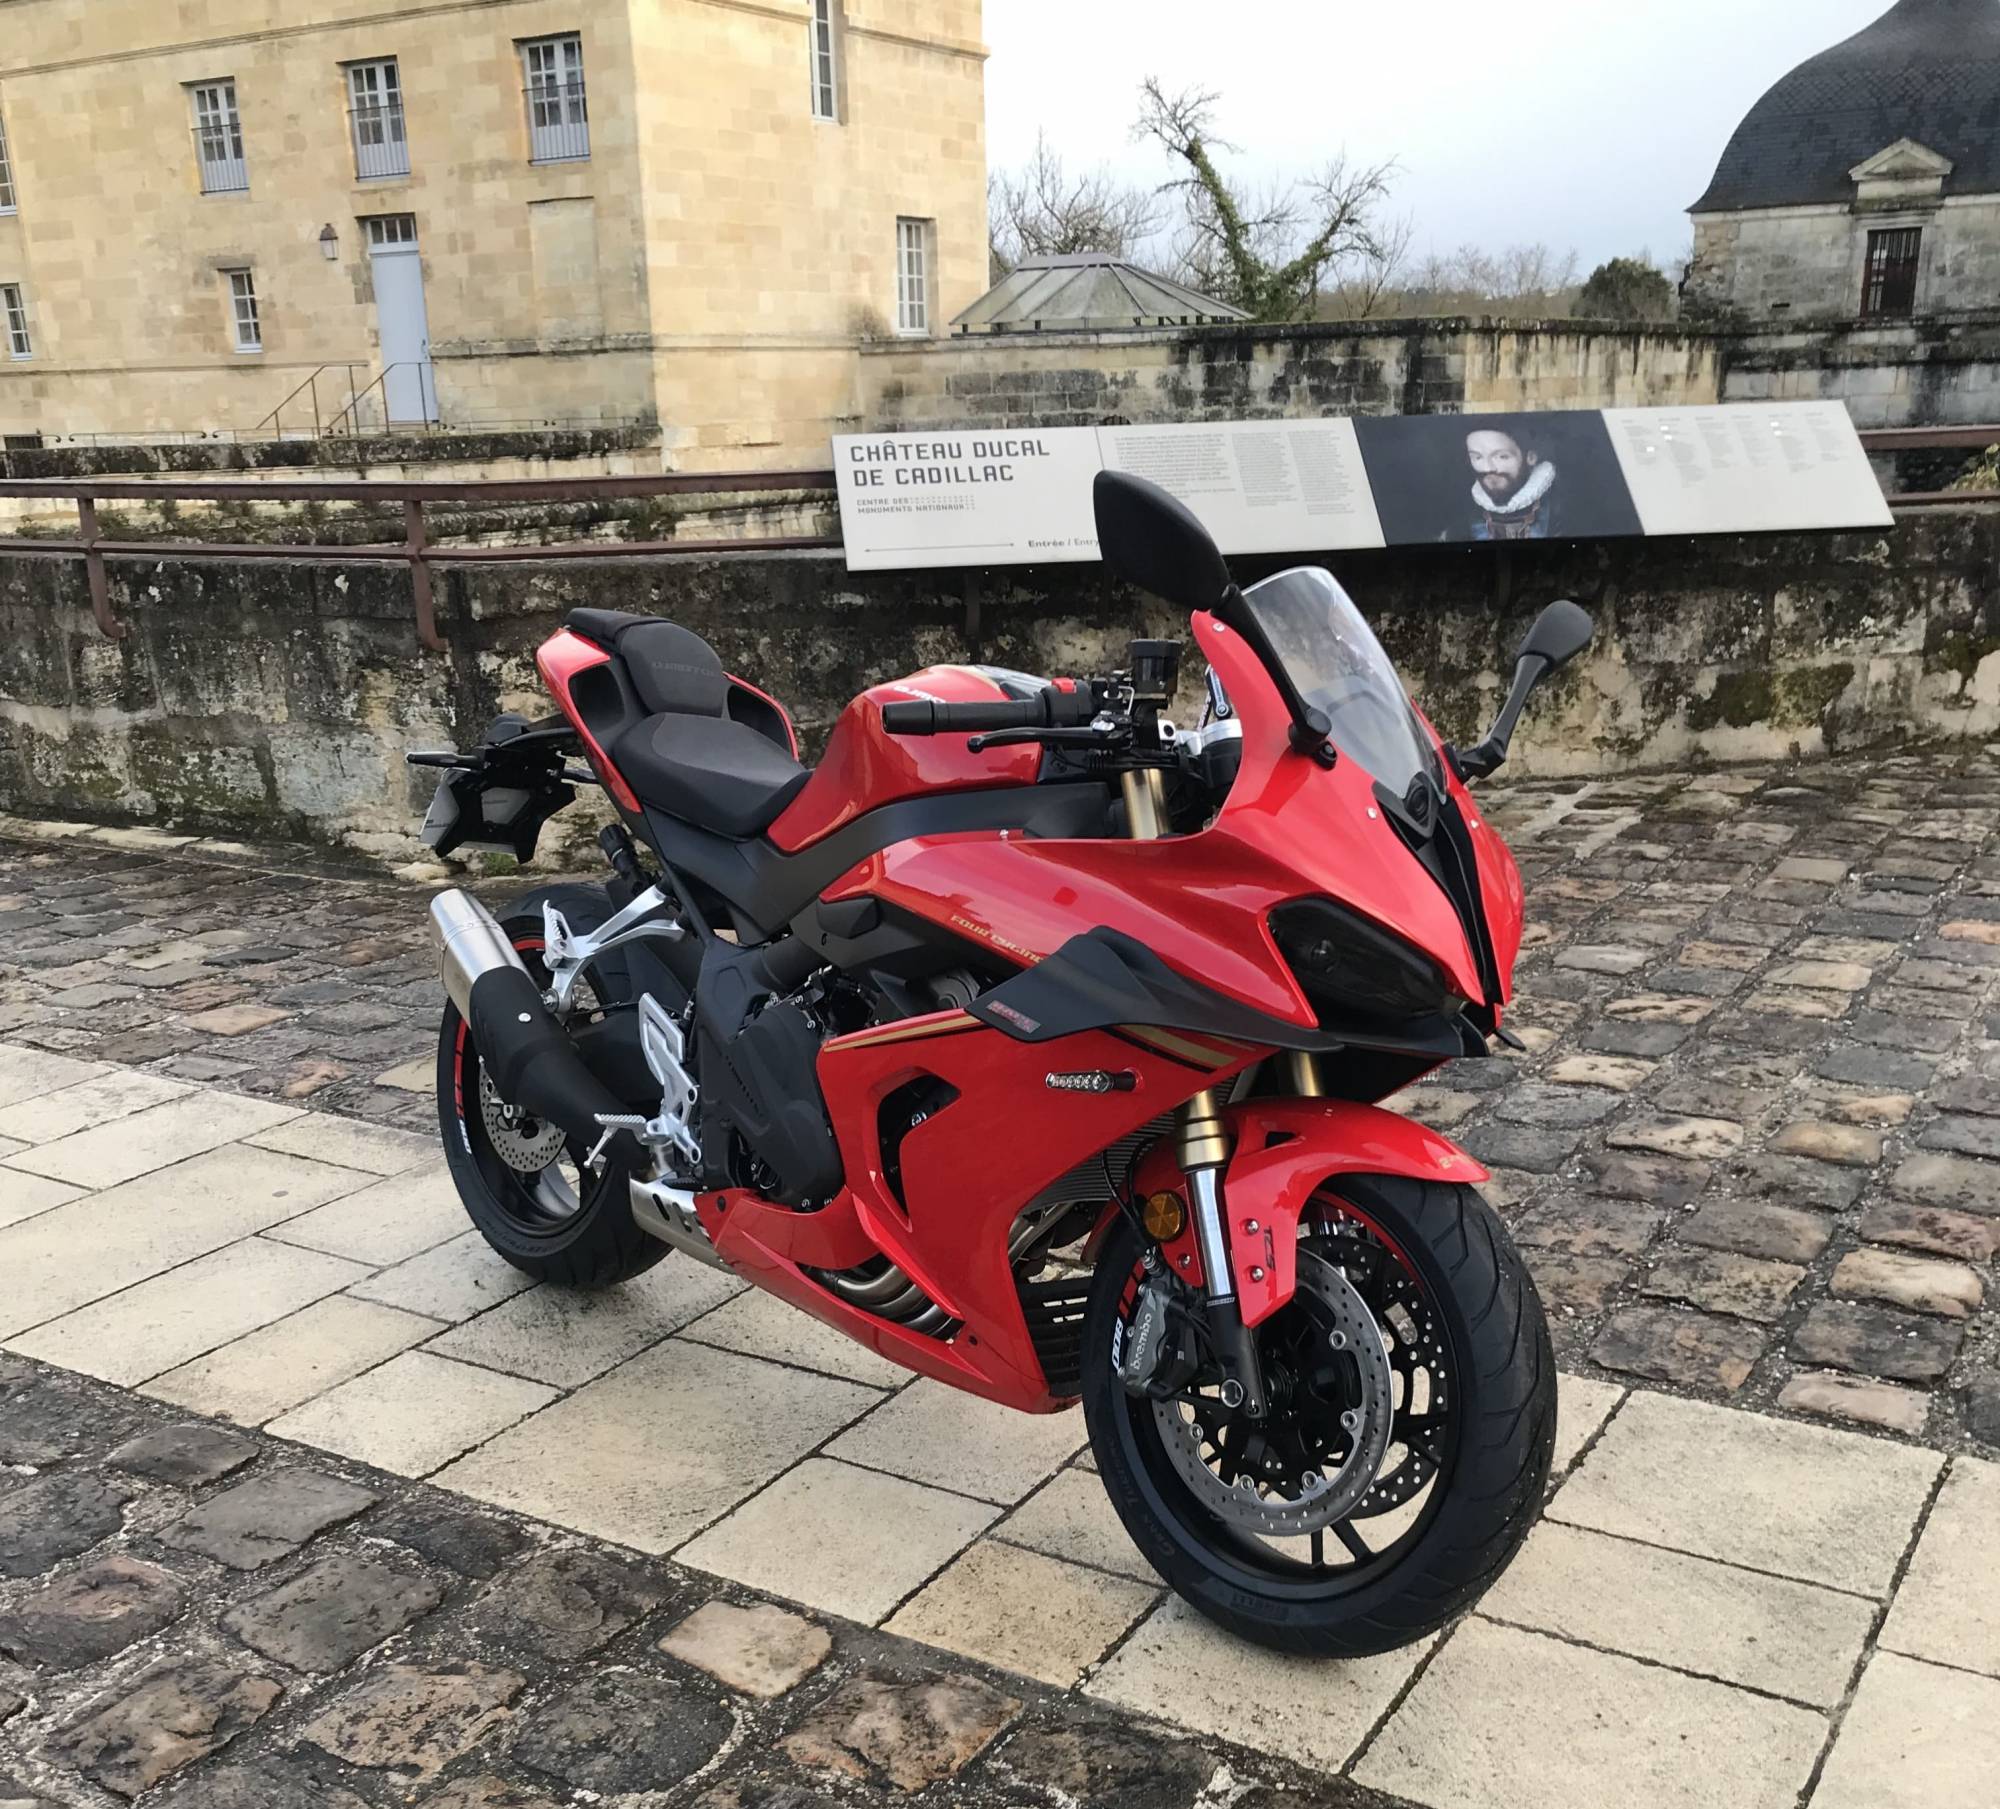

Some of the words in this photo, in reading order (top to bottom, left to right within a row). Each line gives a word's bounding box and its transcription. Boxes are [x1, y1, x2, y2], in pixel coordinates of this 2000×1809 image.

[850, 440, 962, 462] CHÂTEAU
[973, 439, 1050, 459] DUCAL
[853, 469, 884, 487] DE
[895, 464, 1014, 485] CADILLAC
[857, 498, 889, 506] CENTRE
[893, 497, 909, 505] DES
[858, 505, 913, 514] MONUMENTS
[1130, 1312, 1152, 1370] brembo
